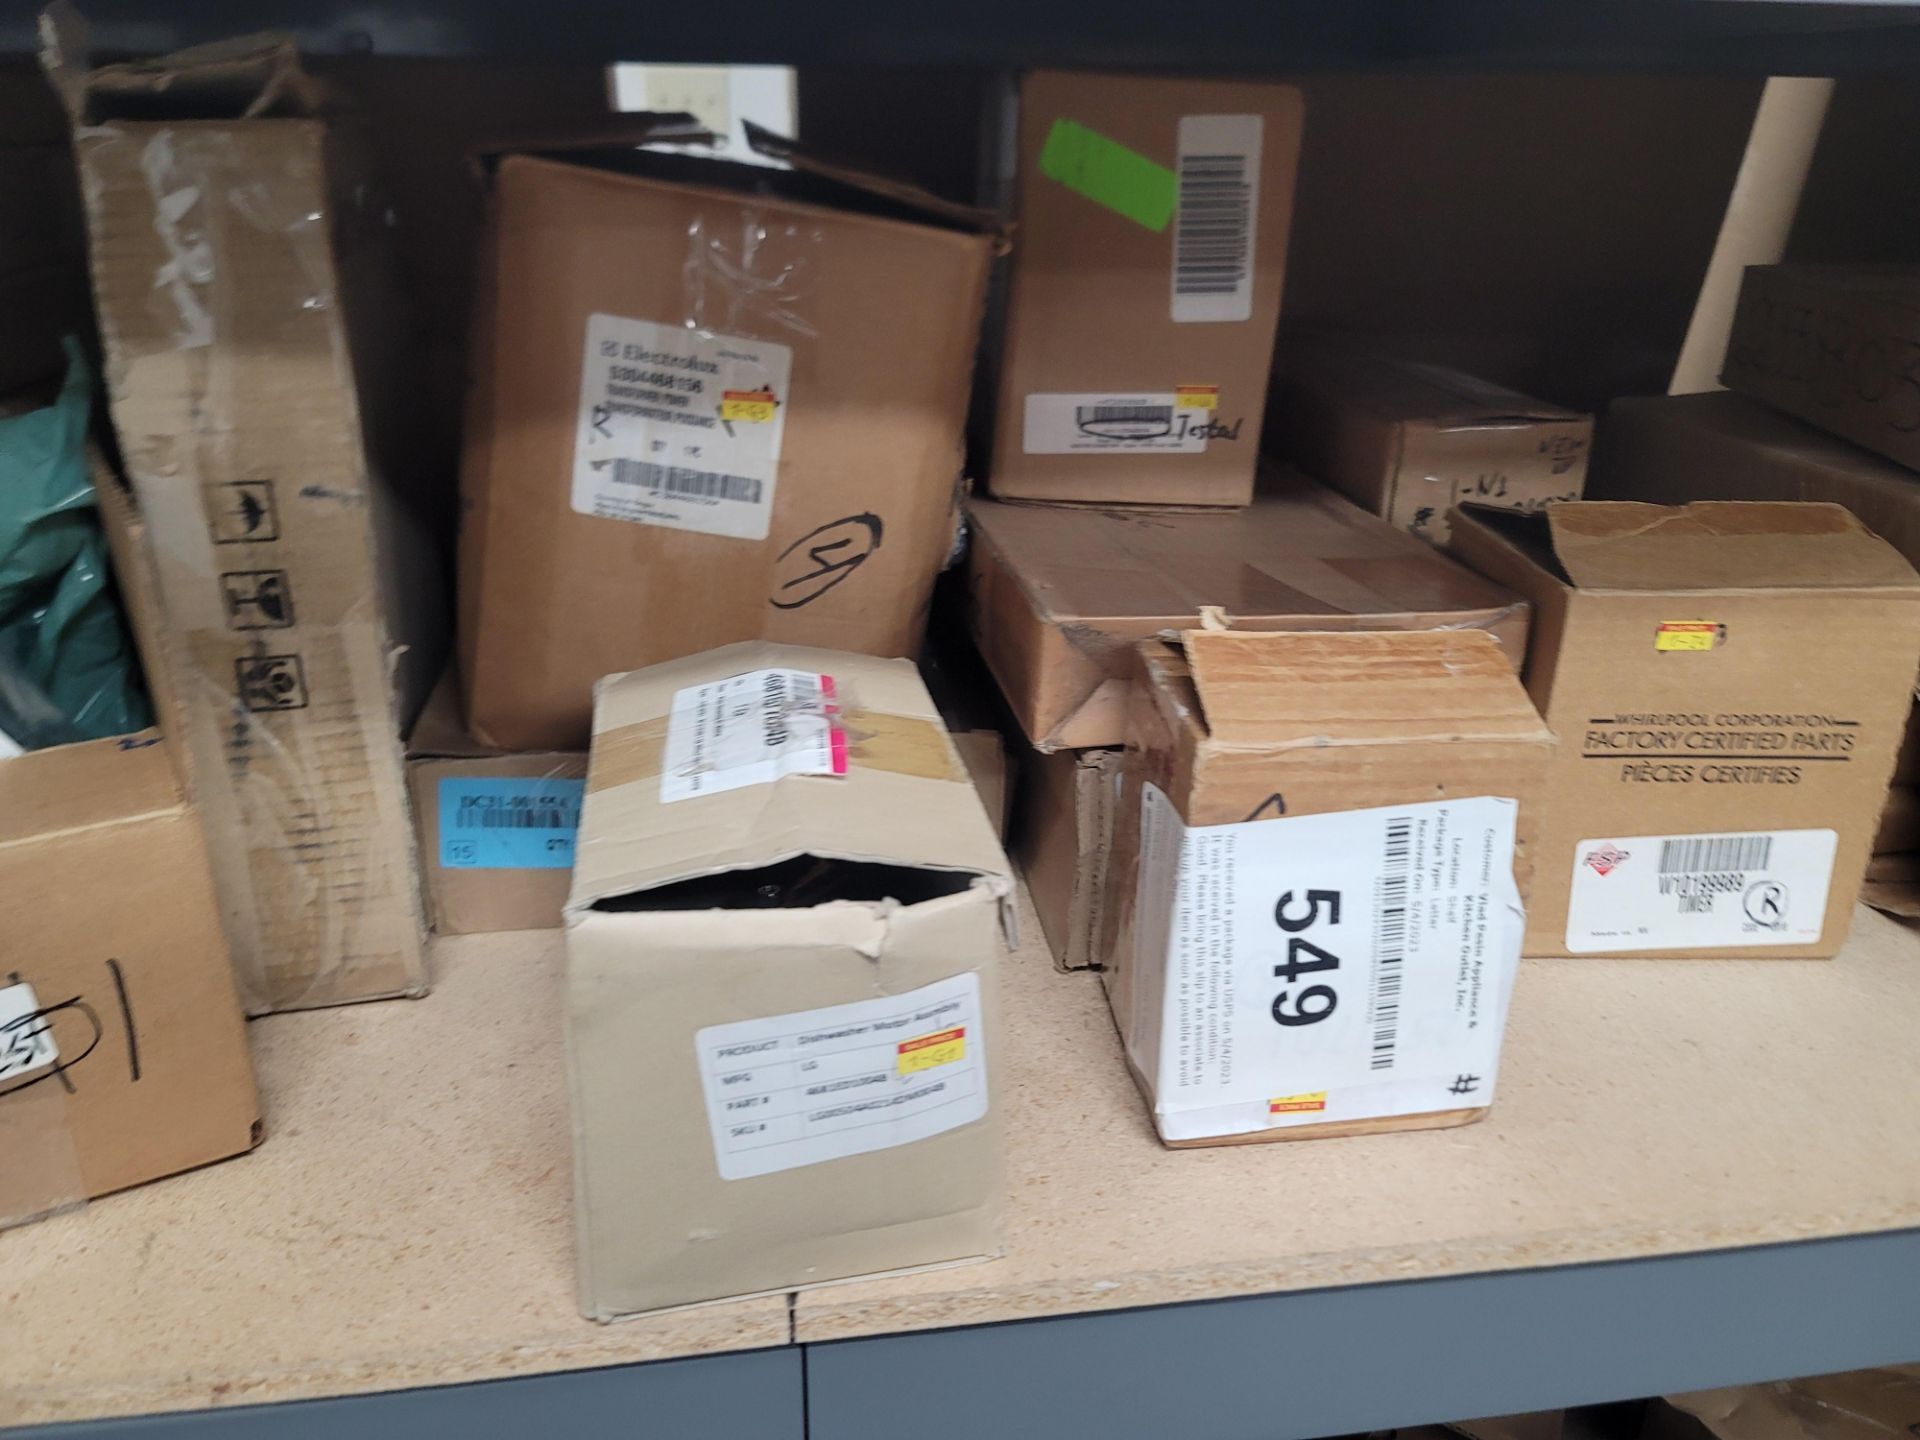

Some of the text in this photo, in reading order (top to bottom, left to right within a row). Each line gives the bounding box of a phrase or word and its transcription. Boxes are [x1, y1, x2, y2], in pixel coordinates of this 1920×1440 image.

[1616, 713, 1835, 728] WHIRLPOOL CORPORATION
[1583, 730, 1857, 752] FACTORY CERTIFIED PARTS
[1620, 760, 1696, 783] PIÈCES
[1226, 834, 1237, 853] You
[1415, 819, 1428, 871] Received
[1481, 828, 1496, 886] Customer:
[1211, 848, 1220, 871] was
[1429, 808, 1449, 930] Package Type: Letter
[1449, 837, 1464, 889] Location:
[1180, 877, 1190, 903] your
[1197, 874, 1207, 910] Please
[1225, 858, 1235, 905] received
[1210, 874, 1221, 921] received
[1181, 907, 1192, 933] item
[1195, 914, 1207, 943] bring
[1409, 900, 1422, 953] 5/4/2023
[1461, 894, 1474, 941] Kitchen
[1196, 946, 1207, 967] this
[1210, 939, 1221, 957] the
[1223, 920, 1234, 965] package
[1180, 953, 1190, 979] soon
[1271, 888, 1341, 1027] 549
[1194, 971, 1206, 989] slip
[1208, 960, 1220, 1009] following
[1223, 969, 1233, 985] via
[1468, 960, 1484, 1017] Appliance
[1223, 988, 1233, 1017] USPS
[1178, 998, 1191, 1042] possible
[1222, 1021, 1231, 1034] on
[717, 1040, 780, 1059] PRODUCT
[797, 1026, 870, 1045] Dishwasher
[872, 1015, 912, 1031] Motor
[1194, 1024, 1205, 1072] associate
[1179, 1059, 1190, 1087] avoid
[726, 1097, 759, 1111] PART
[730, 1125, 757, 1138] SKU
